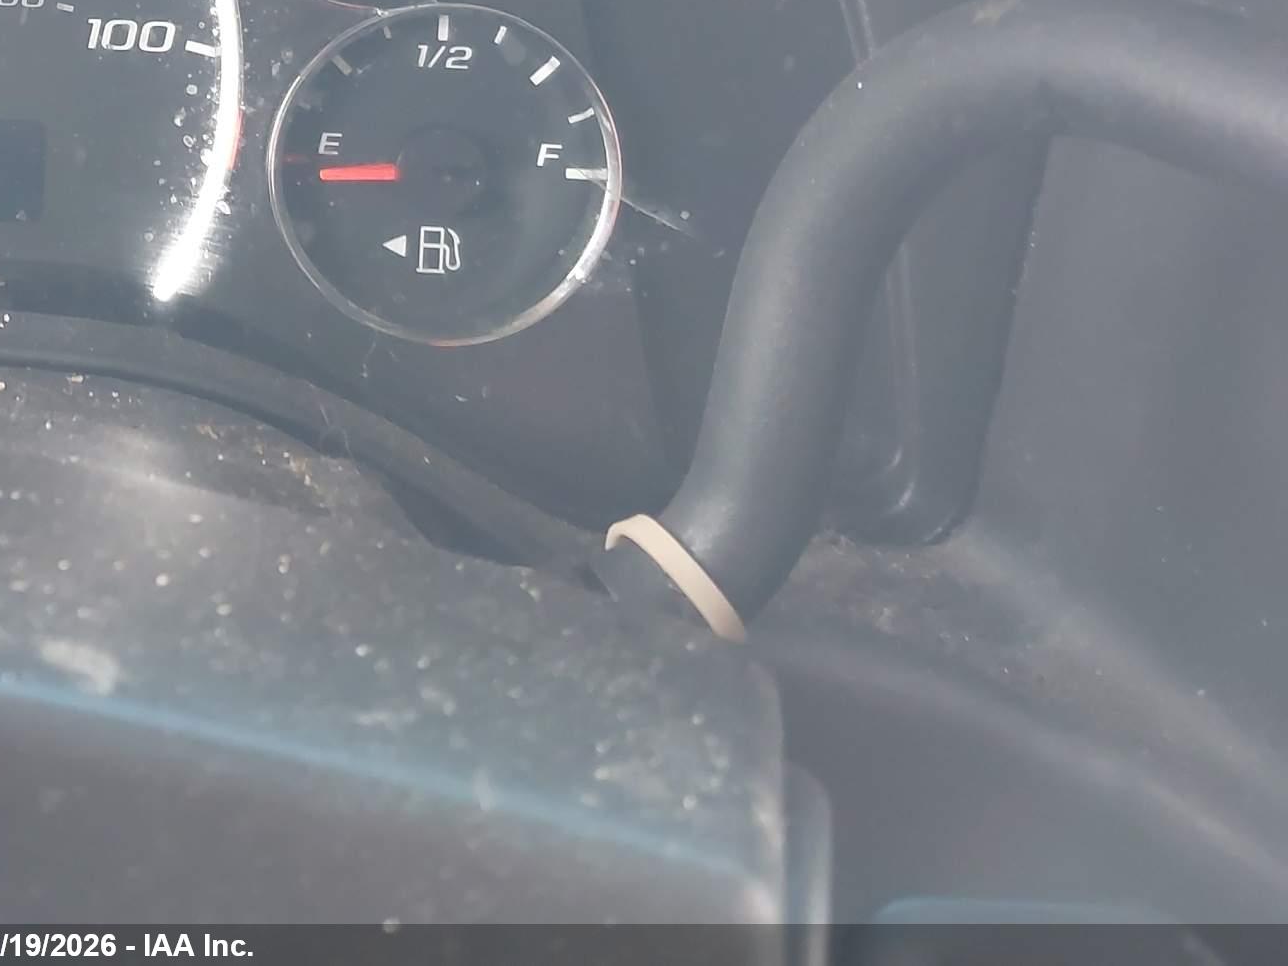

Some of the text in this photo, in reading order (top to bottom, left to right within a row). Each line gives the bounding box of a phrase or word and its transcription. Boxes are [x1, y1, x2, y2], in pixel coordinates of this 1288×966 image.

[88, 18, 177, 56] 100
[415, 44, 472, 71] 1/2
[318, 133, 343, 156] E
[536, 143, 563, 167] F
